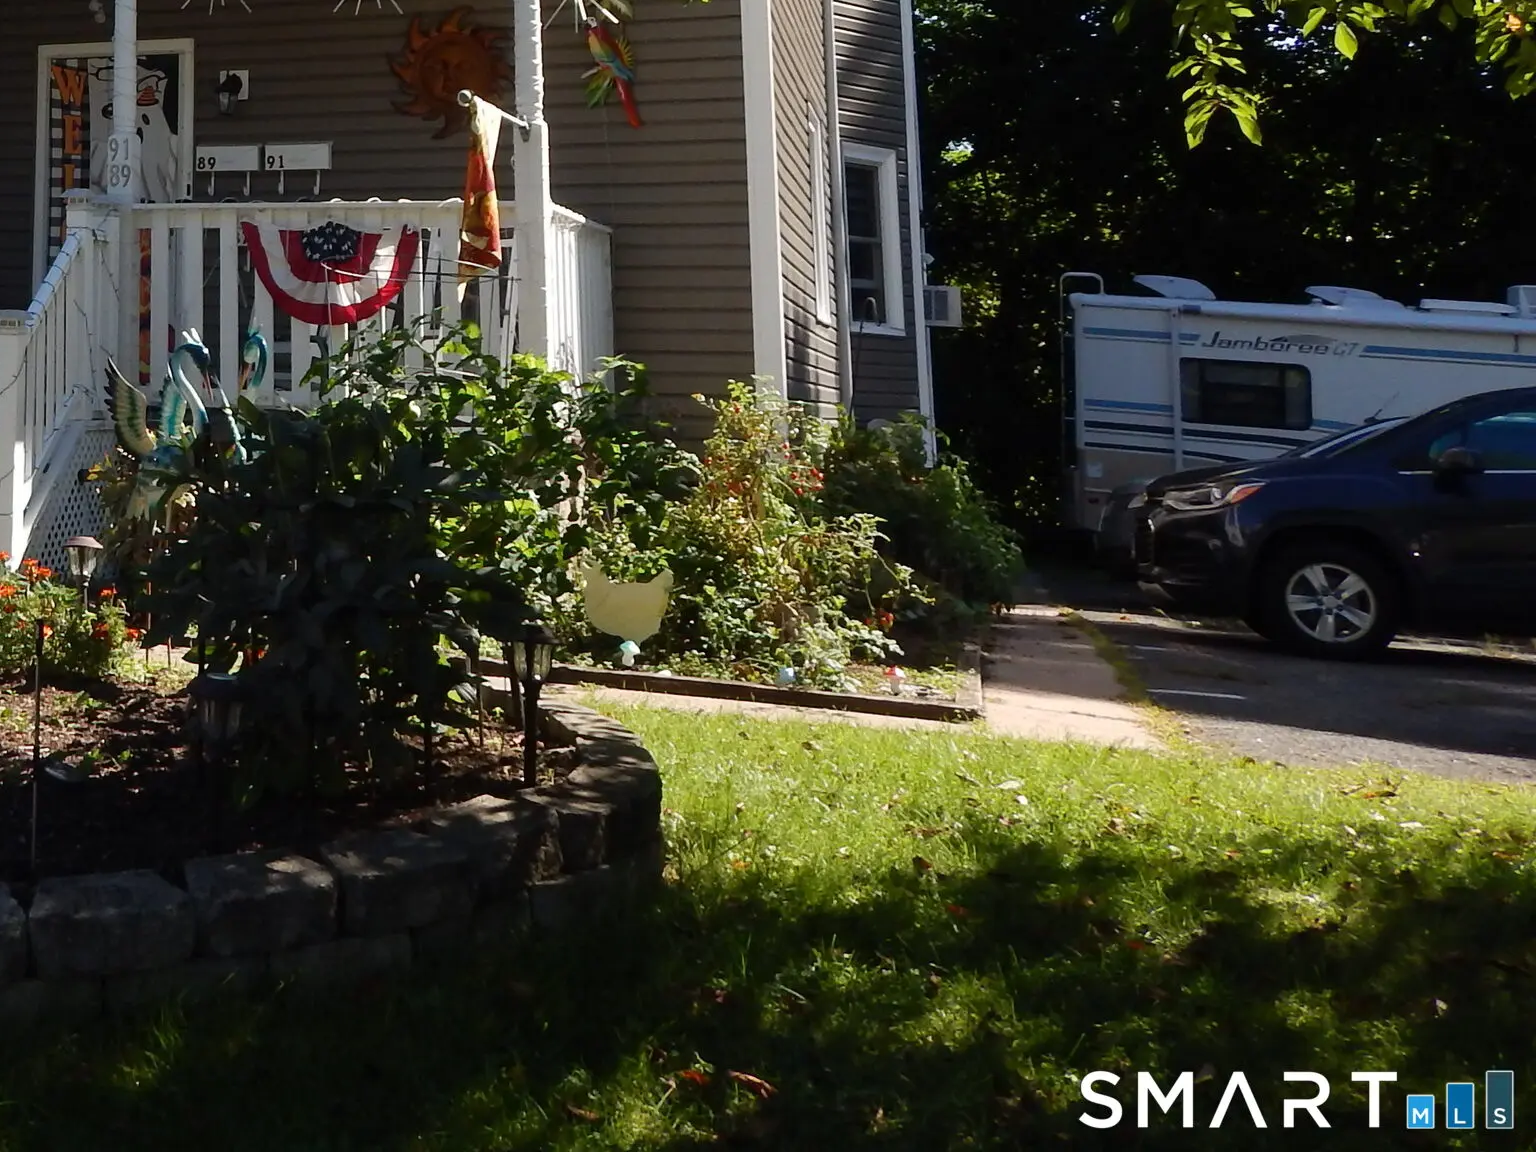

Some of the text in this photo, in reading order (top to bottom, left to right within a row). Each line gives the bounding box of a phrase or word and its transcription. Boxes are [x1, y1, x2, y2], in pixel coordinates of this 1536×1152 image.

[108, 137, 130, 162] 91
[197, 156, 216, 170] 89
[266, 155, 284, 169] 91
[109, 164, 132, 188] 89
[1201, 330, 1329, 355] Jamboree
